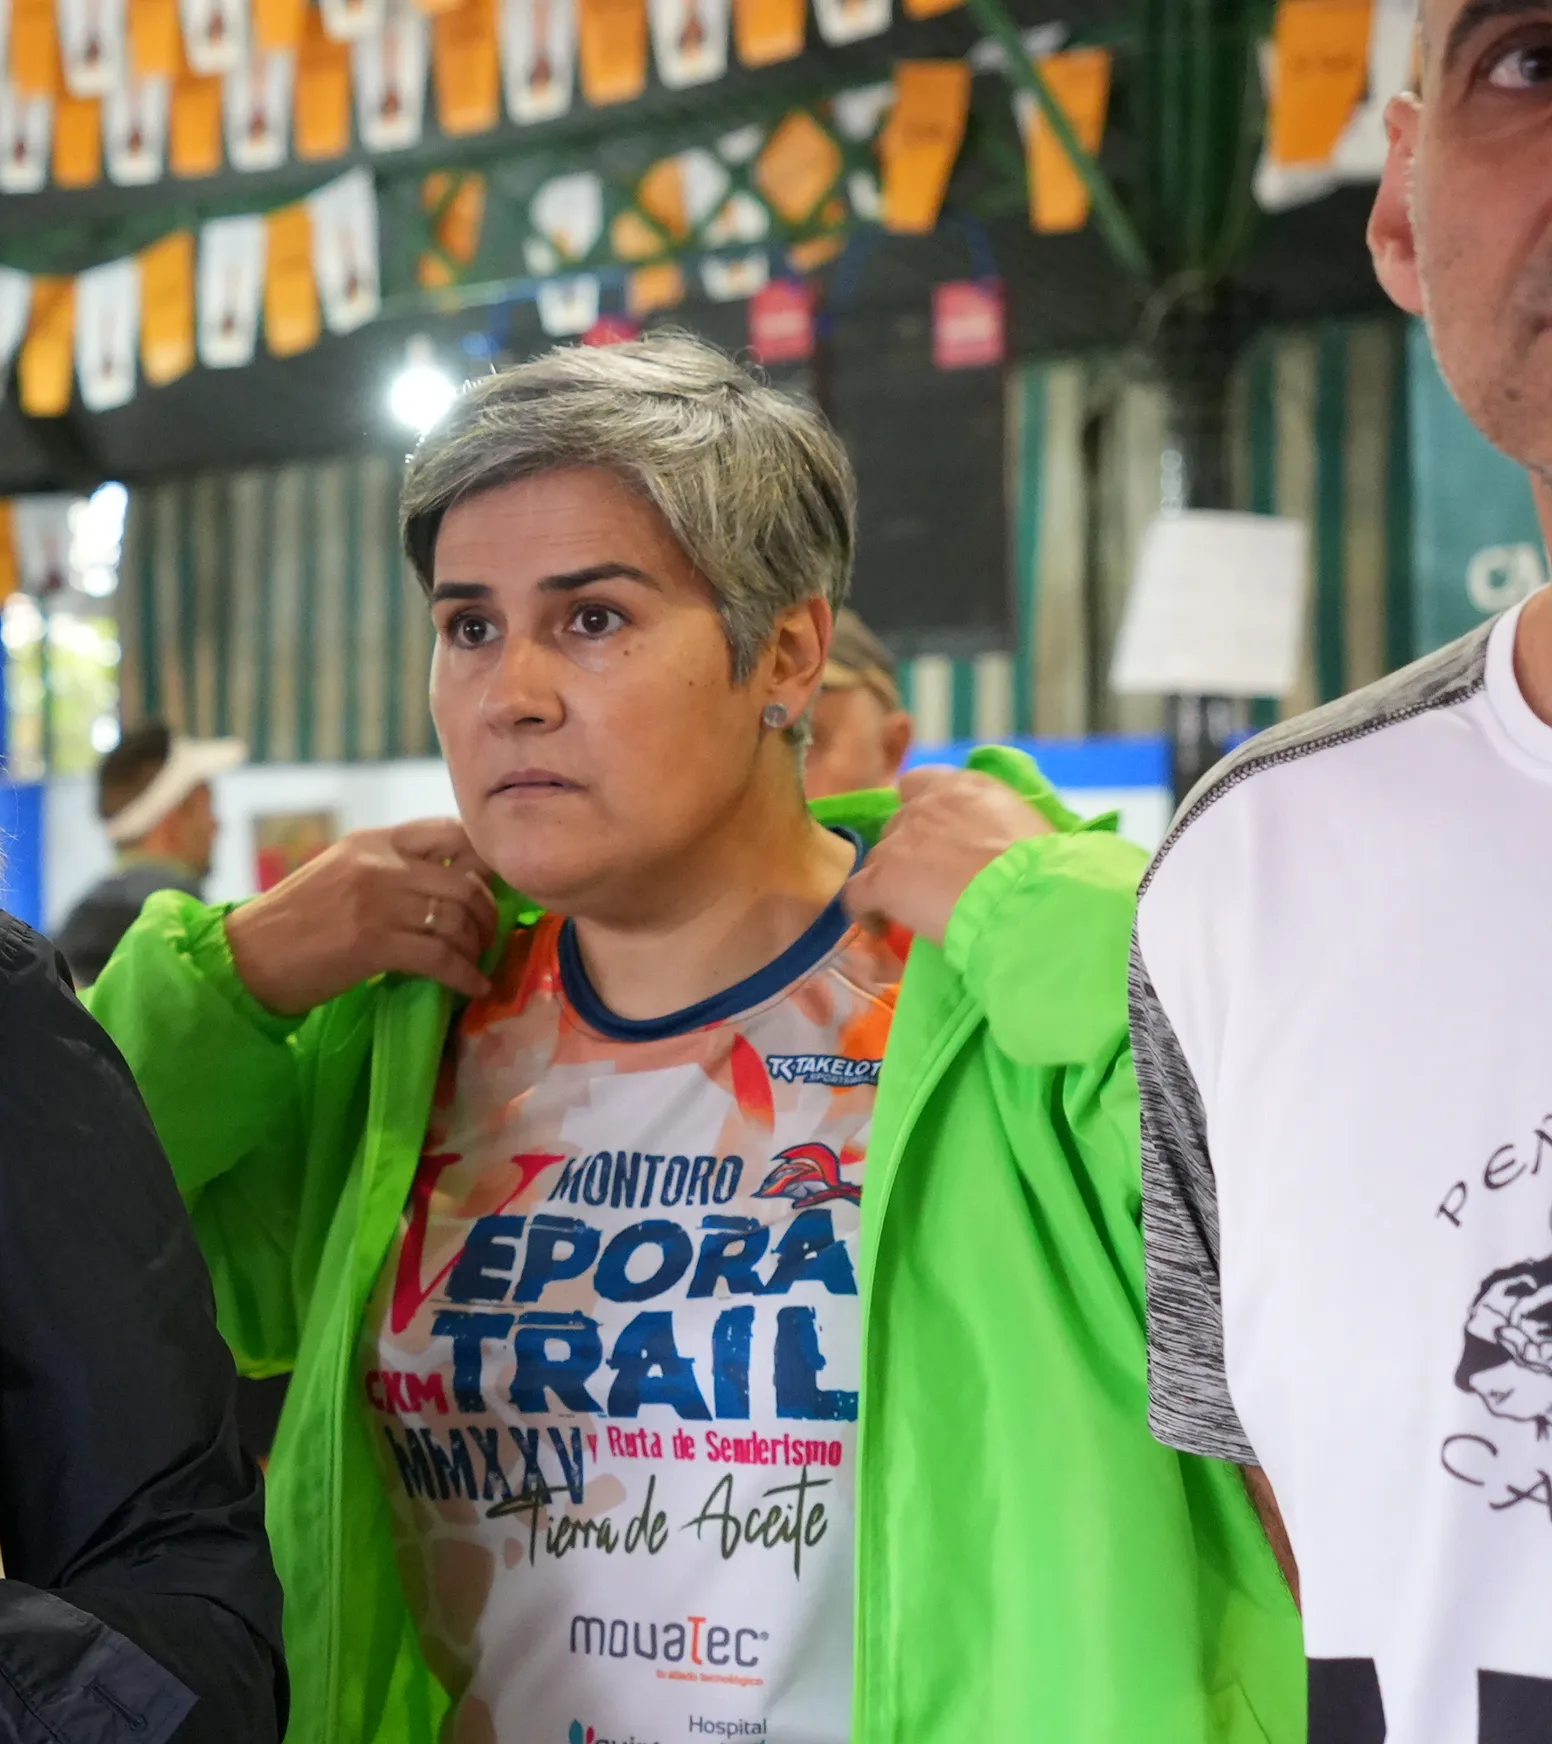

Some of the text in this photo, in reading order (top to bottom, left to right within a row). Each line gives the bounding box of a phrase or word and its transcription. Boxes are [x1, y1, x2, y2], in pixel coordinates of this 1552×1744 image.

[548, 1150, 744, 1208] MONTORO
[391, 1153, 566, 1334] V
[444, 1209, 858, 1303] EPORA
[431, 1305, 860, 1421] TRAIL
[384, 1425, 583, 1504] MMXXV
[607, 1425, 663, 1458] Ruta
[672, 1427, 696, 1460] de
[705, 1430, 843, 1466] Senderismo
[486, 1464, 833, 1582] Tierra de Aceite
[689, 1714, 767, 1739] Hospital
